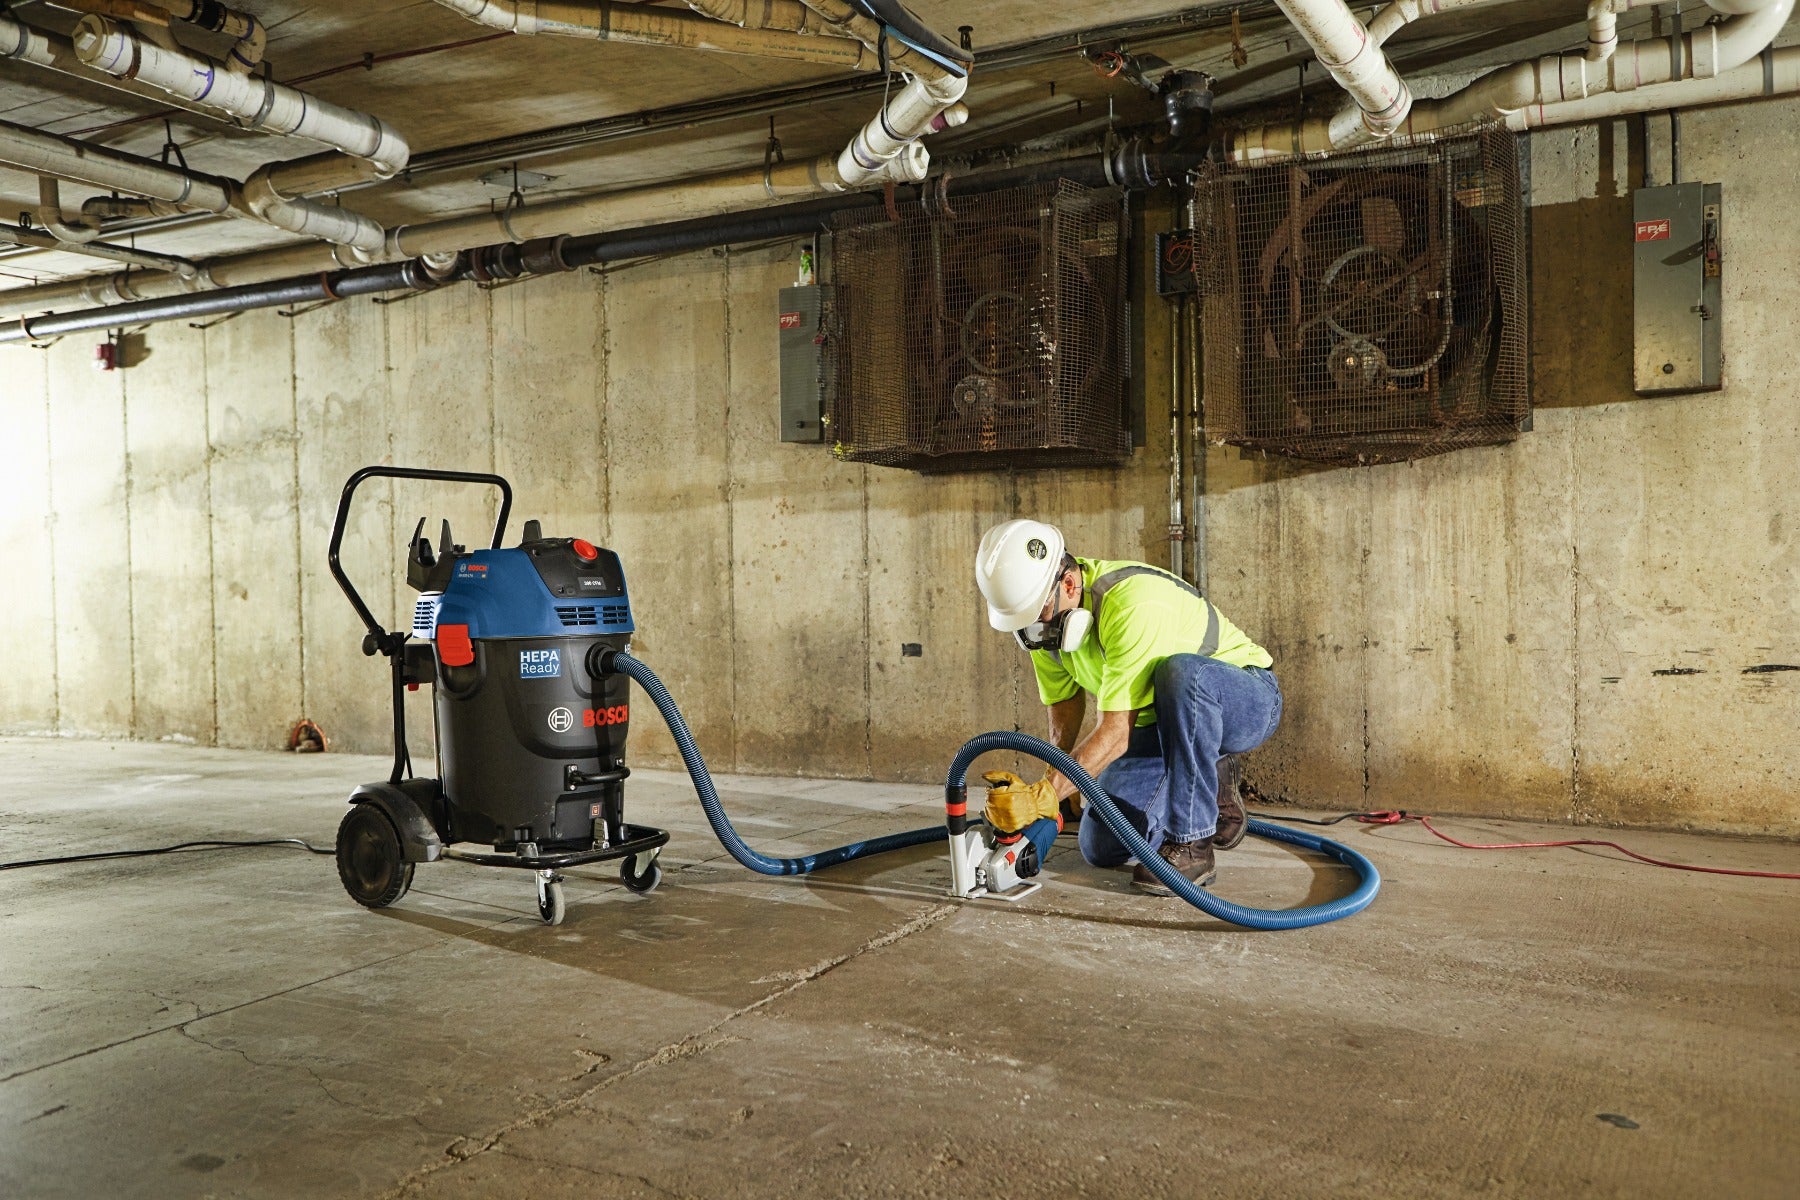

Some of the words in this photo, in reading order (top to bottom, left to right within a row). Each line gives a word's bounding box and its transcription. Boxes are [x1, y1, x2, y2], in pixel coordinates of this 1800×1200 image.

[520, 650, 559, 663] HEPA
[520, 662, 560, 675] Ready
[583, 704, 628, 728] BOSCH
